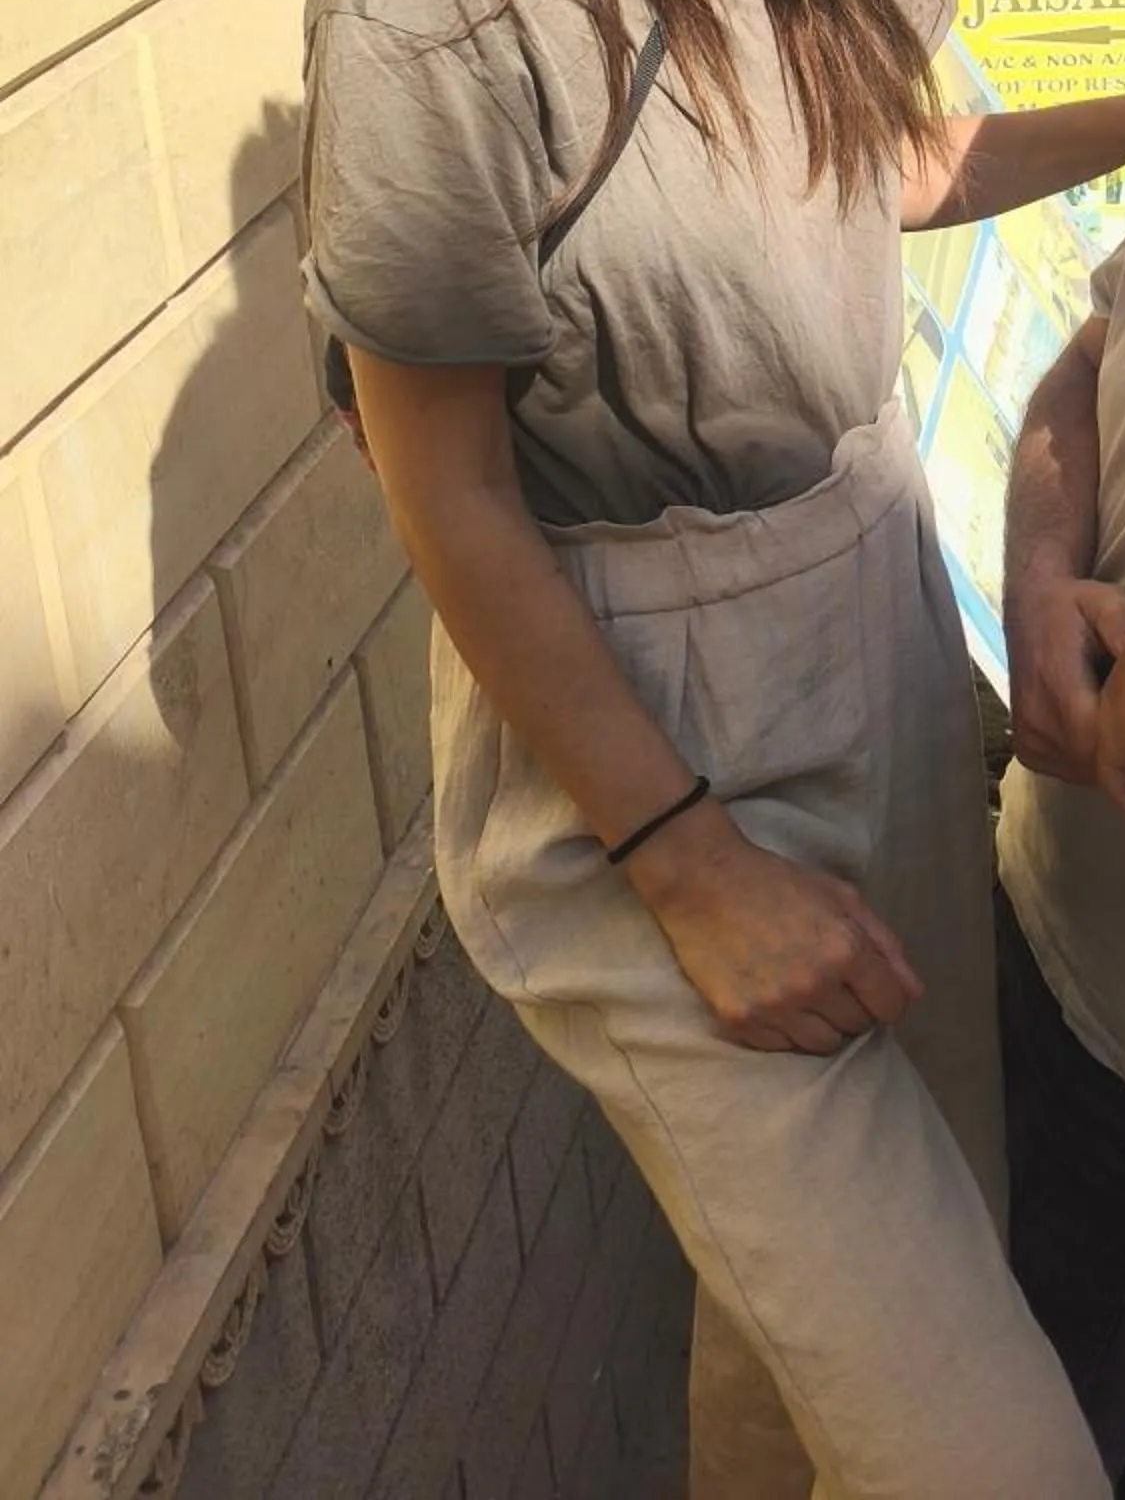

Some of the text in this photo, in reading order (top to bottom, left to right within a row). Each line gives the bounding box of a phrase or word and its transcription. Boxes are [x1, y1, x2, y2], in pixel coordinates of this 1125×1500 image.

[1022, 55, 1037, 69] &
[1047, 53, 1093, 68] NON
[1035, 78, 1079, 94] TOP
